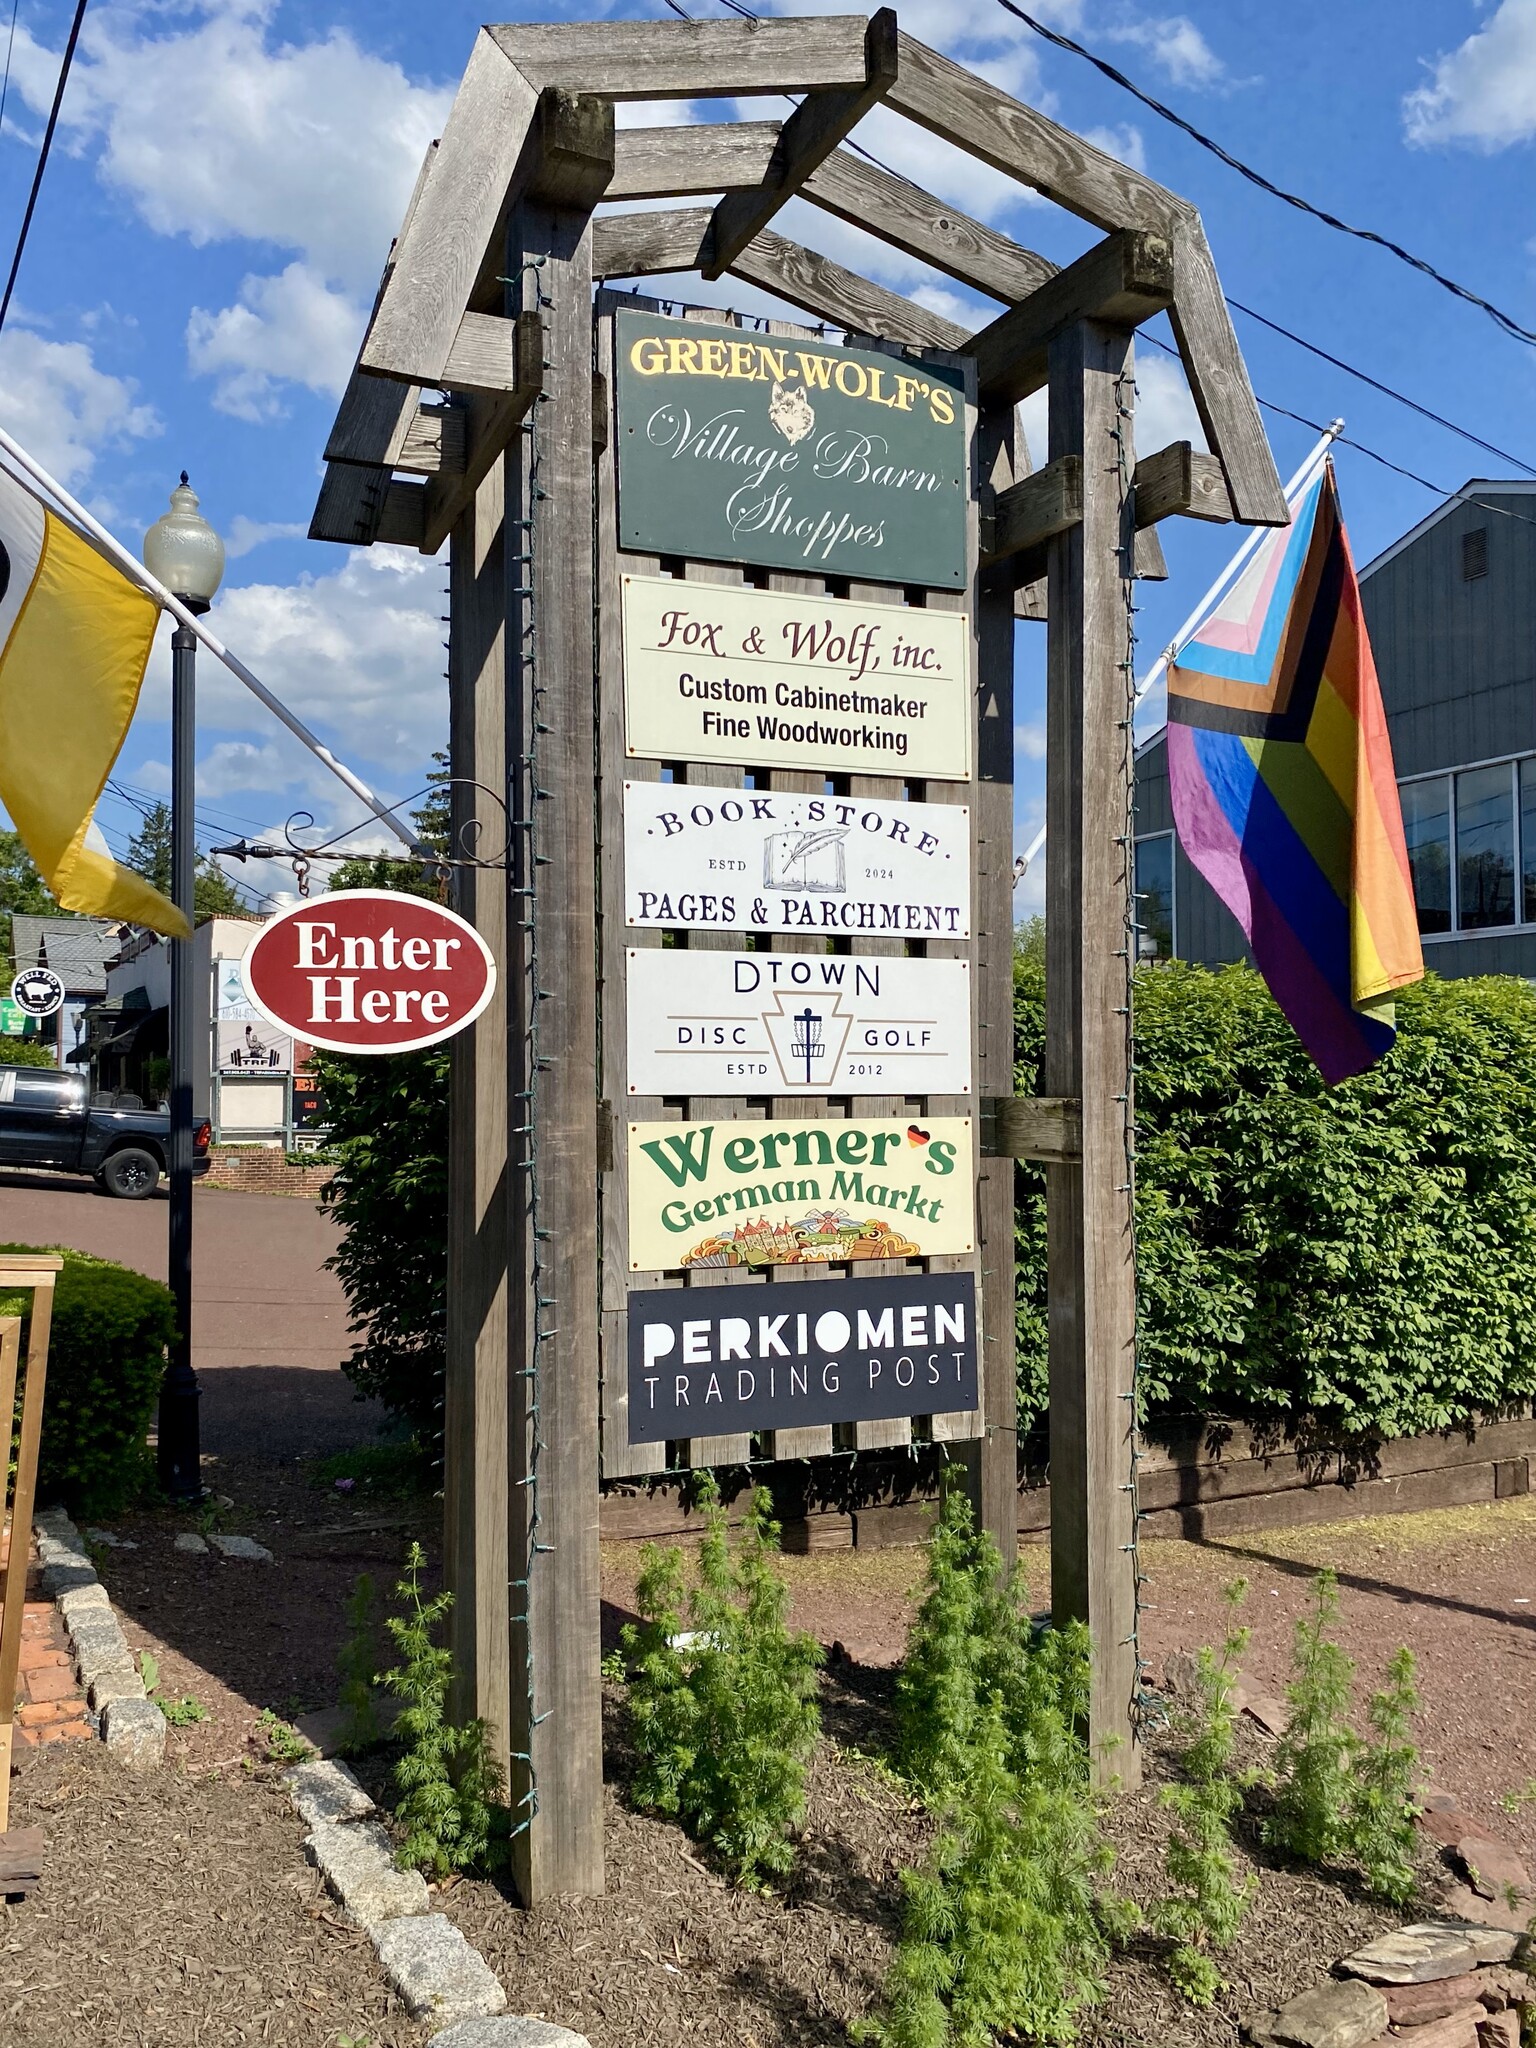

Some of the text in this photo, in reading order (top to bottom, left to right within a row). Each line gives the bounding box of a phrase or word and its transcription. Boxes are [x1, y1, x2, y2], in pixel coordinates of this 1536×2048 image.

[630, 336, 956, 426] GREEN-WOLF'S
[646, 403, 943, 492] Village Barn
[726, 483, 884, 560] Shoppes
[658, 610, 942, 681] Fox & Wolf, inc.
[678, 673, 928, 719] Custom Cabinetmaker
[702, 711, 908, 756] Fine Woodworking
[656, 798, 940, 857] BOOK STORE
[708, 859, 894, 880] ESTD 2024
[638, 892, 960, 932] PAGES & PARCHMENT
[293, 921, 461, 972] Enter
[18, 971, 58, 985] WELL FED
[306, 975, 450, 1024] Here
[734, 960, 880, 997] DTOWN
[678, 1026, 932, 1047] DISC GOLF
[727, 1063, 882, 1076] ESTD 2012
[661, 1170, 945, 1233] German Markt
[643, 1303, 966, 1368] PERKIOMEN
[644, 1352, 965, 1410] TRADING POST
